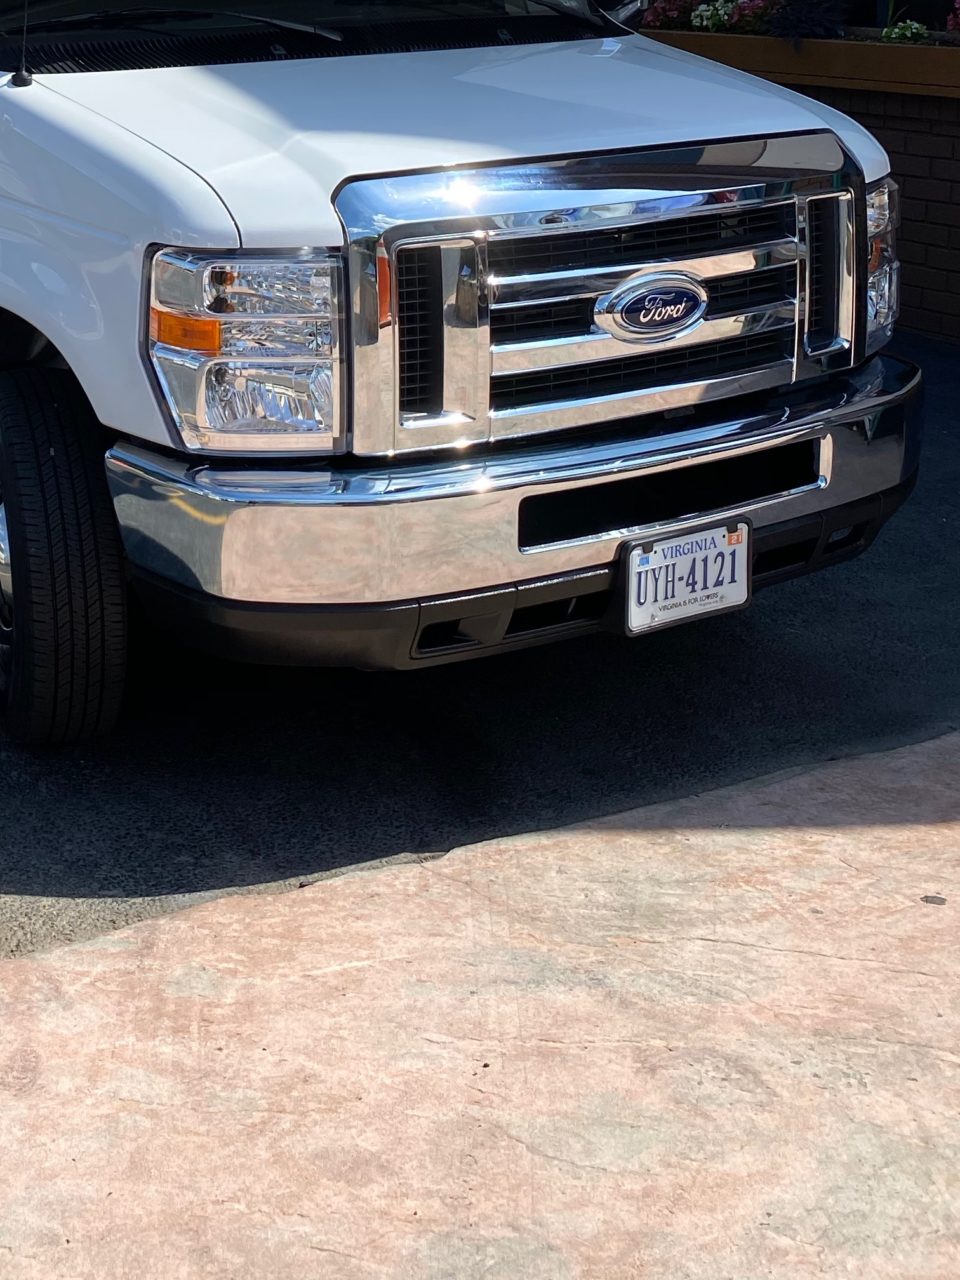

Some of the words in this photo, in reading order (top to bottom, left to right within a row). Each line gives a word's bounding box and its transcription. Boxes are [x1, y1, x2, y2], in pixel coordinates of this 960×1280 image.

[640, 293, 687, 323] Ford
[661, 536, 718, 560] VIRGINIA
[637, 548, 736, 606] UYH-4121
[658, 602, 683, 612] VIRGINIA
[688, 597, 699, 605] FOR
[699, 592, 719, 602] LOVERS
